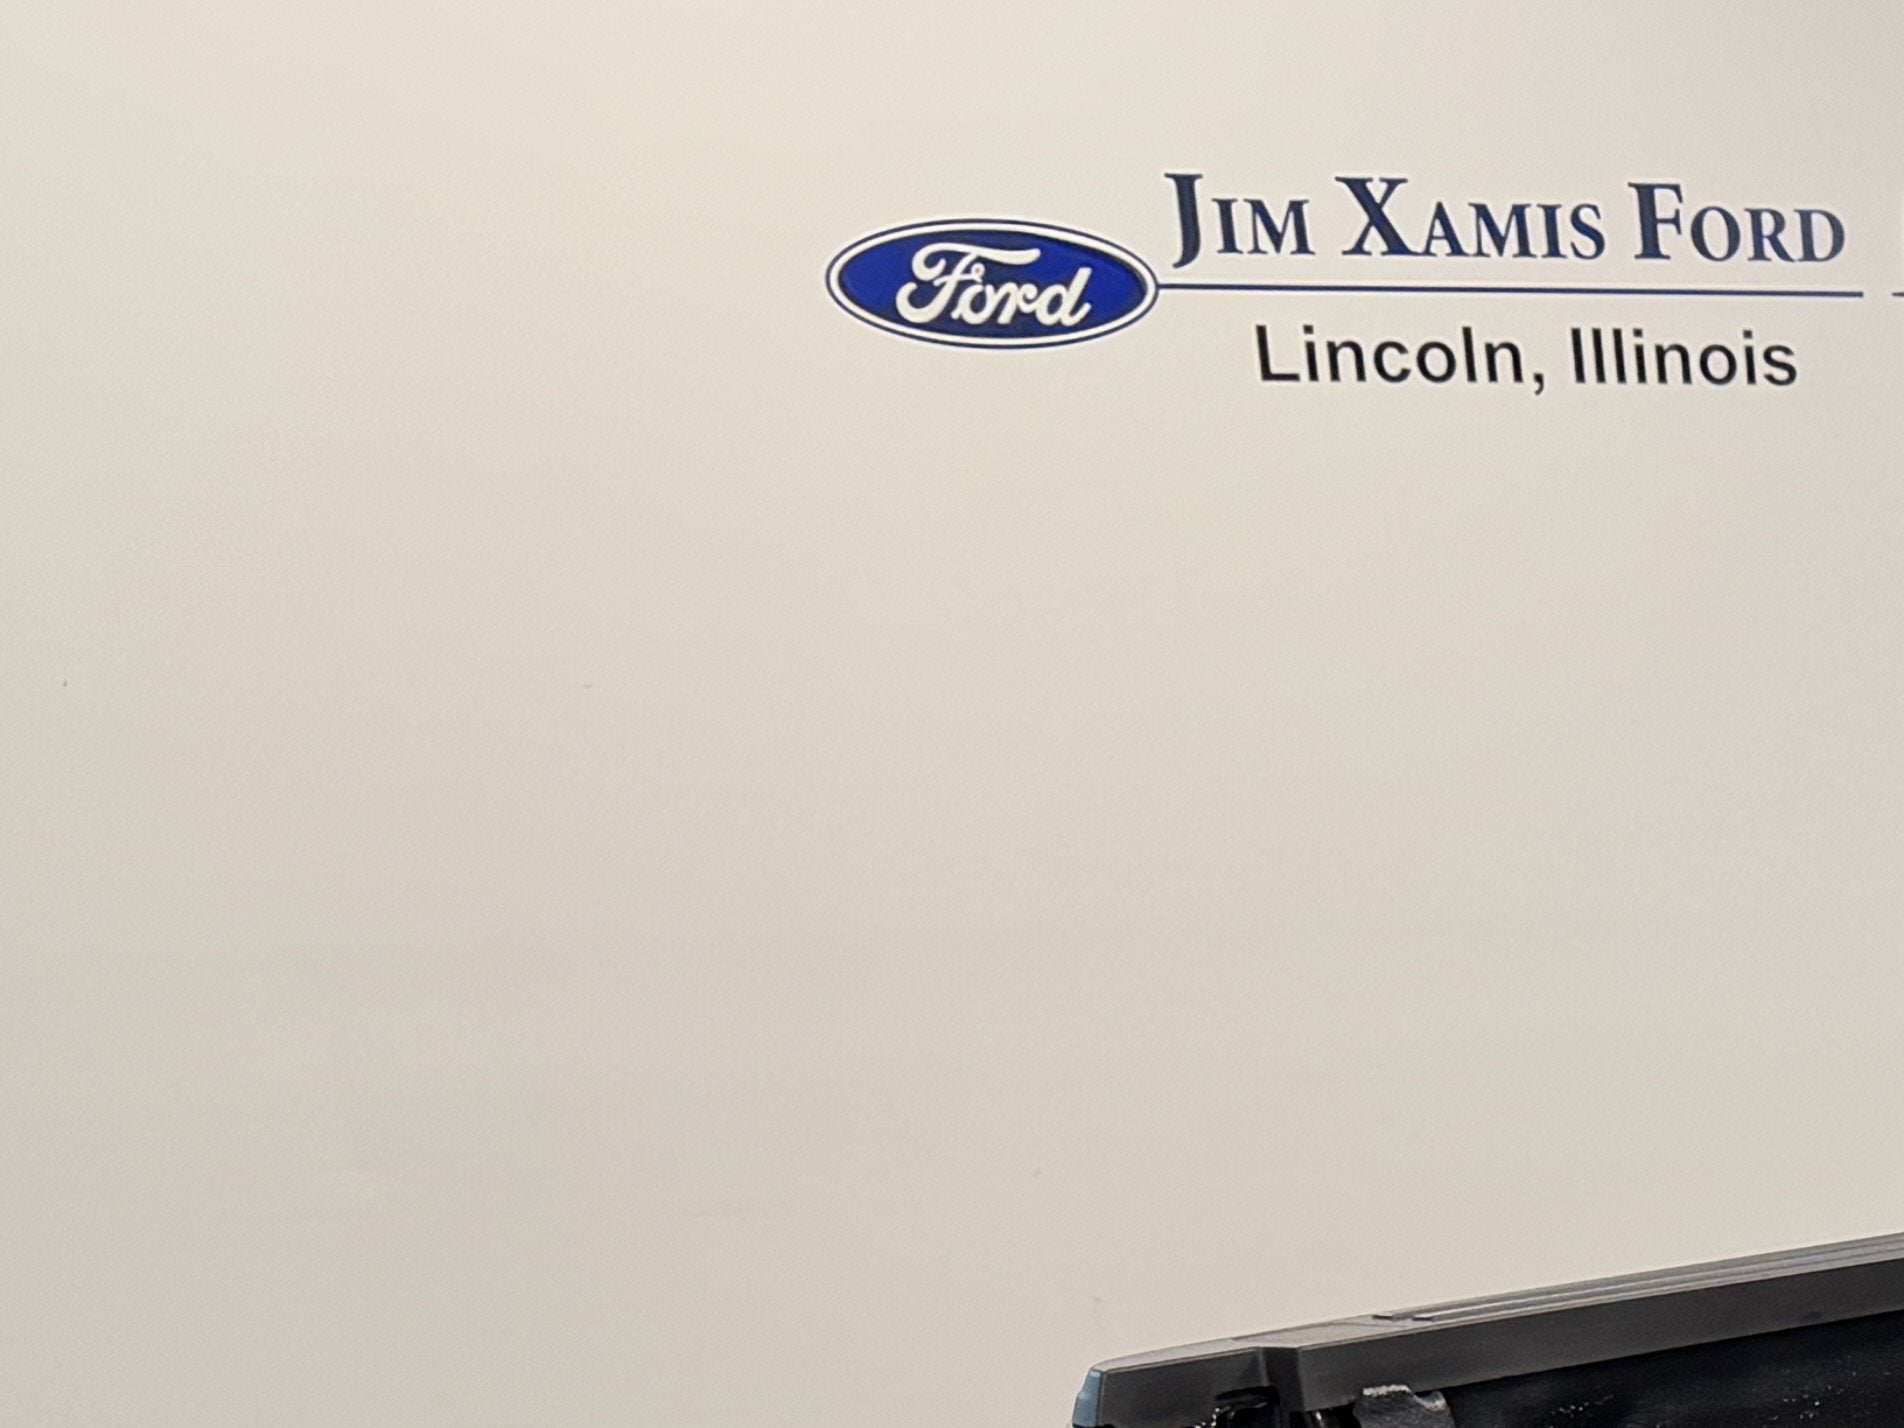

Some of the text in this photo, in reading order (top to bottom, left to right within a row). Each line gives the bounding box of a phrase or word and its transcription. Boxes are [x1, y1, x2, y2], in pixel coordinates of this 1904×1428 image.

[1164, 172, 1845, 269] JIM XAMIS FORD
[894, 242, 1092, 327] Ford
[1255, 324, 1797, 397] Lincoln, Illinois
